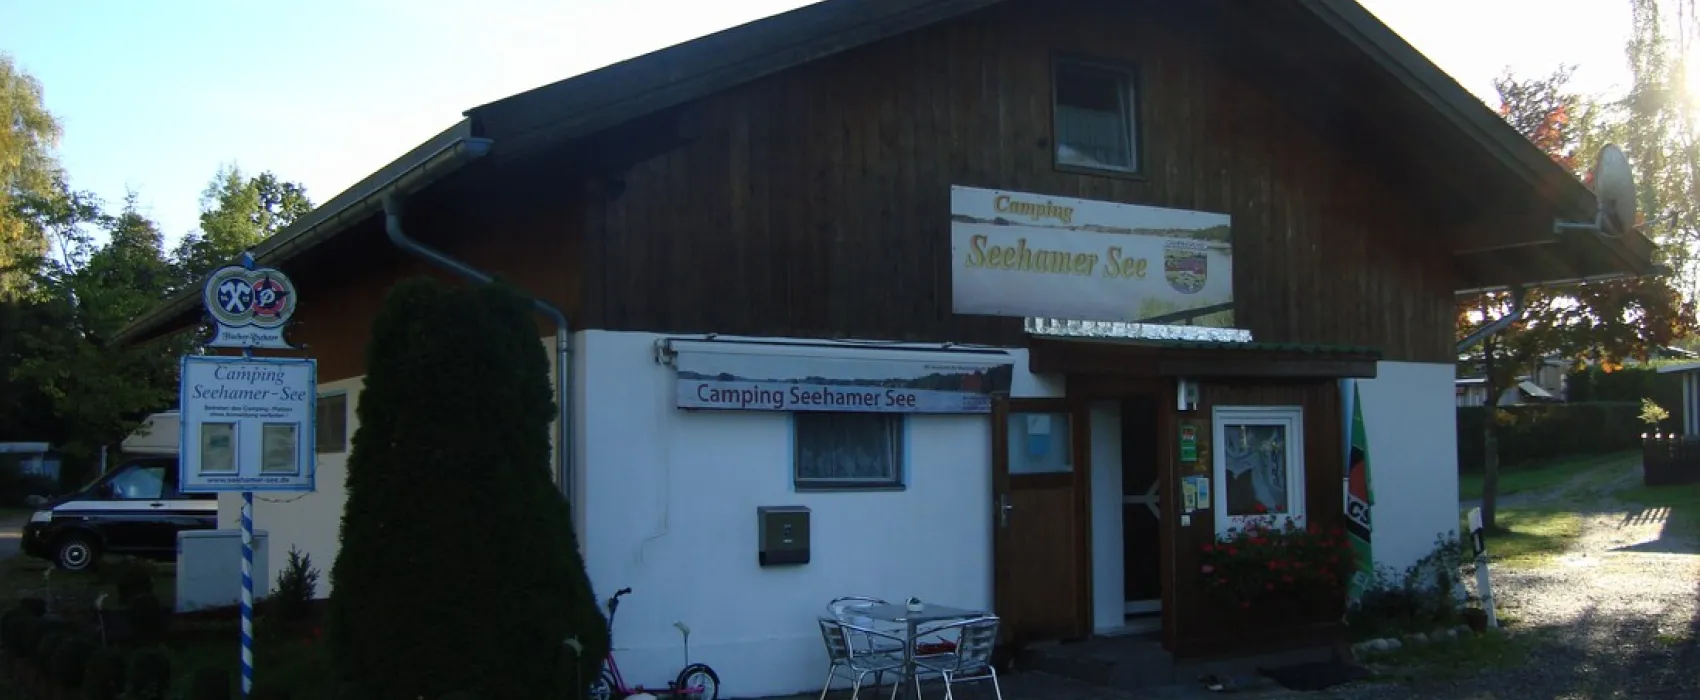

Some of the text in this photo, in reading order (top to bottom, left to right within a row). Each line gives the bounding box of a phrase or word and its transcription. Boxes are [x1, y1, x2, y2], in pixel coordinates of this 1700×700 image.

[993, 194, 1074, 224] Camping
[965, 234, 1148, 279] Seehamer See
[214, 365, 285, 385] Camping
[697, 384, 916, 409] Camping Seehamer See
